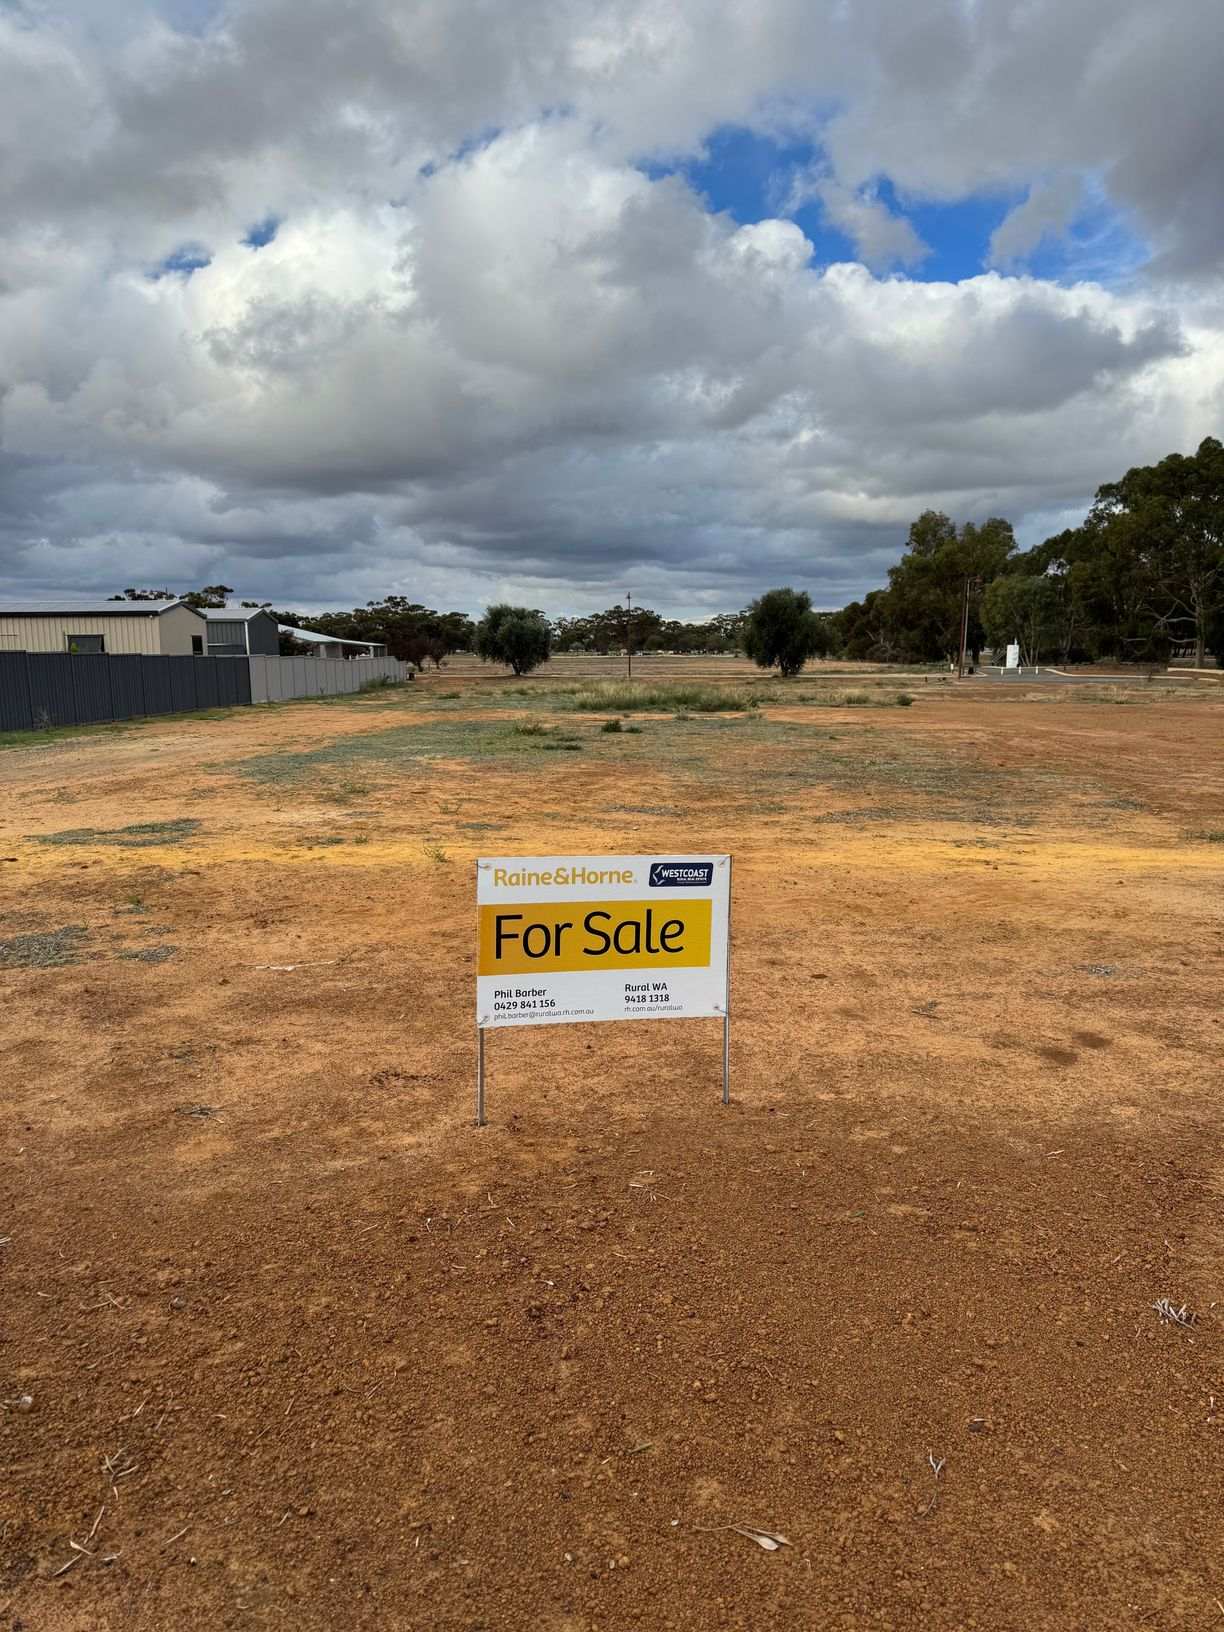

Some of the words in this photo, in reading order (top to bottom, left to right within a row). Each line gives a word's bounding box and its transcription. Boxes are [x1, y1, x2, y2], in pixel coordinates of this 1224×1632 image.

[661, 869, 709, 878] WESTCOAST
[495, 914, 573, 960] For
[582, 909, 685, 956] Sale
[494, 989, 513, 999] Phil
[515, 987, 547, 998] Barber
[624, 983, 650, 992] Rural
[652, 983, 668, 992] WA
[624, 995, 647, 1004] 9418
[649, 994, 670, 1003] 1318
[494, 1001, 518, 1011] 0429
[520, 1000, 537, 1010] 841
[539, 999, 556, 1009] 156
[624, 1004, 682, 1012] rh.com.au/ruralwa
[494, 1009, 594, 1021] phil.barber@ruralwa.rh.com.au
